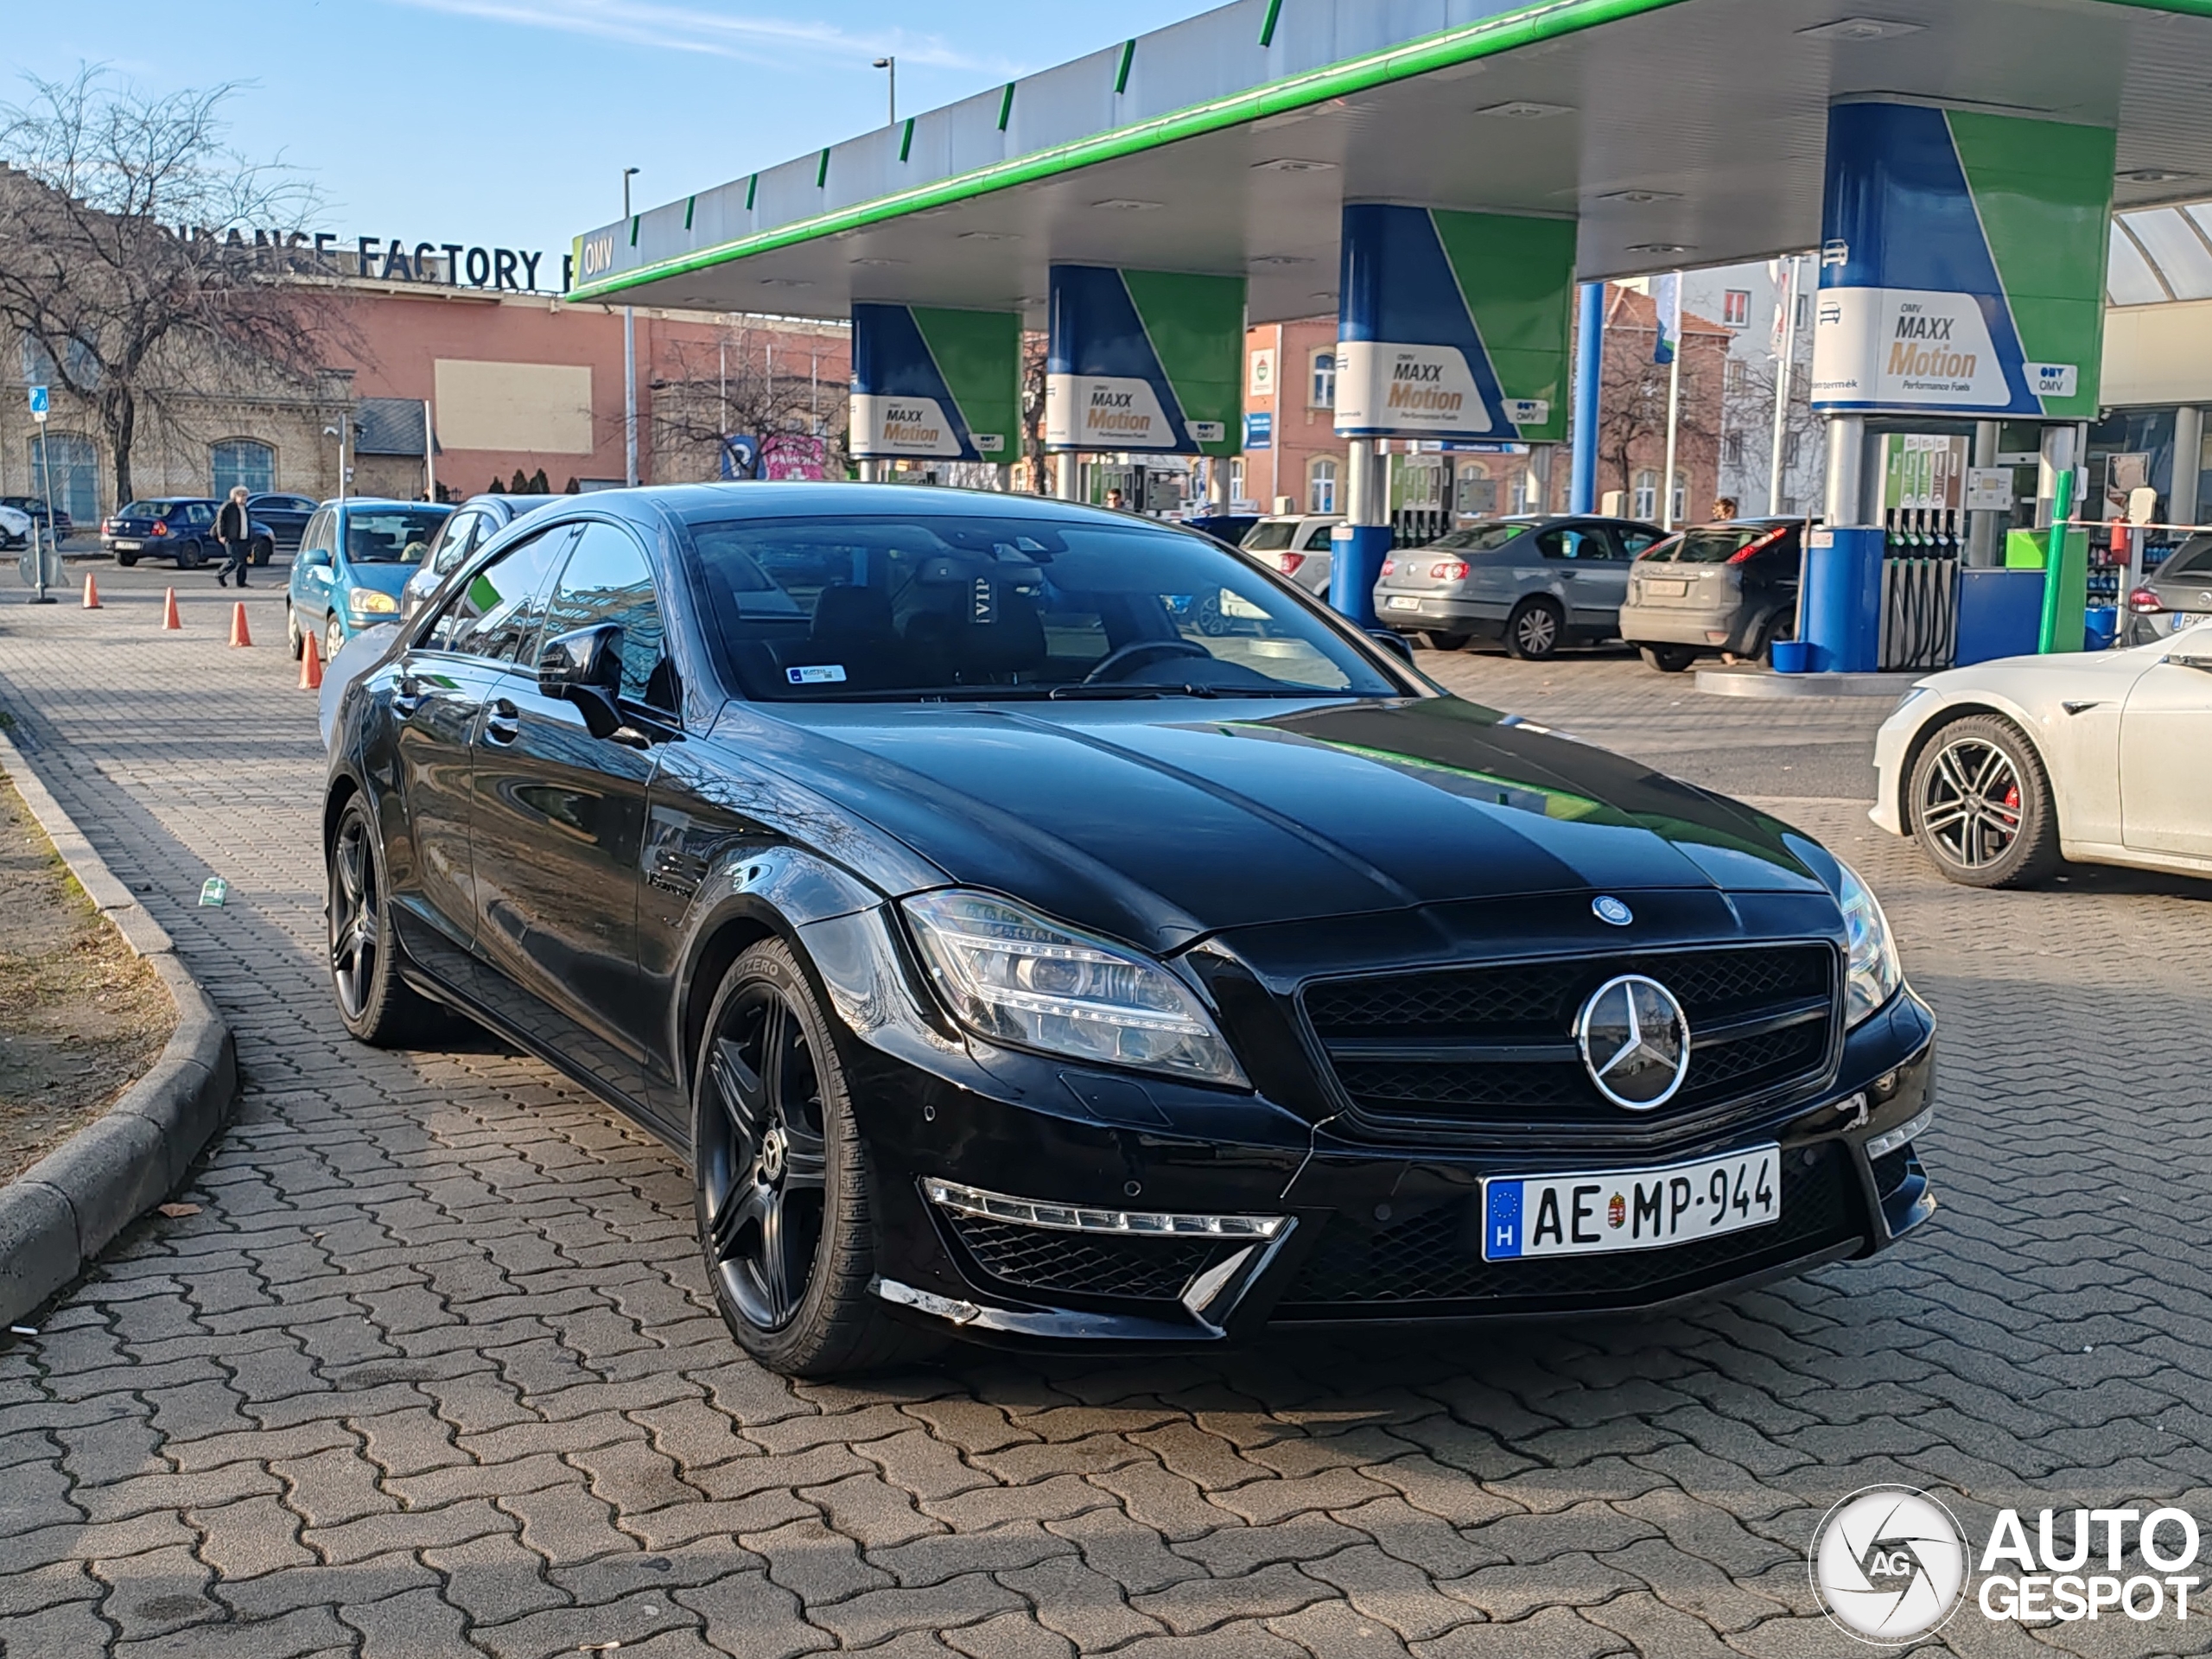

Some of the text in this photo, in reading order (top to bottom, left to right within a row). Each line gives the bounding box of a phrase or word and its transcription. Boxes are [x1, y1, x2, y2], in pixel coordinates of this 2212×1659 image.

[358, 236, 543, 291] FACTORY
[584, 236, 614, 276] OMV
[1901, 303, 1923, 315] OMV
[1895, 315, 1955, 340] MAXX
[1887, 341, 1977, 378] Motion
[1394, 363, 1443, 382] MAXX
[1388, 382, 1463, 411] Motion
[2039, 379, 2063, 391] OMV
[1090, 392, 1134, 408] MAXX
[887, 409, 924, 423] MAXX
[1087, 409, 1151, 431] Motion
[883, 423, 939, 442] Motion
[976, 578, 990, 616] VIP
[1533, 1157, 1772, 1247] AE MP-944
[1496, 1224, 1513, 1247] H
